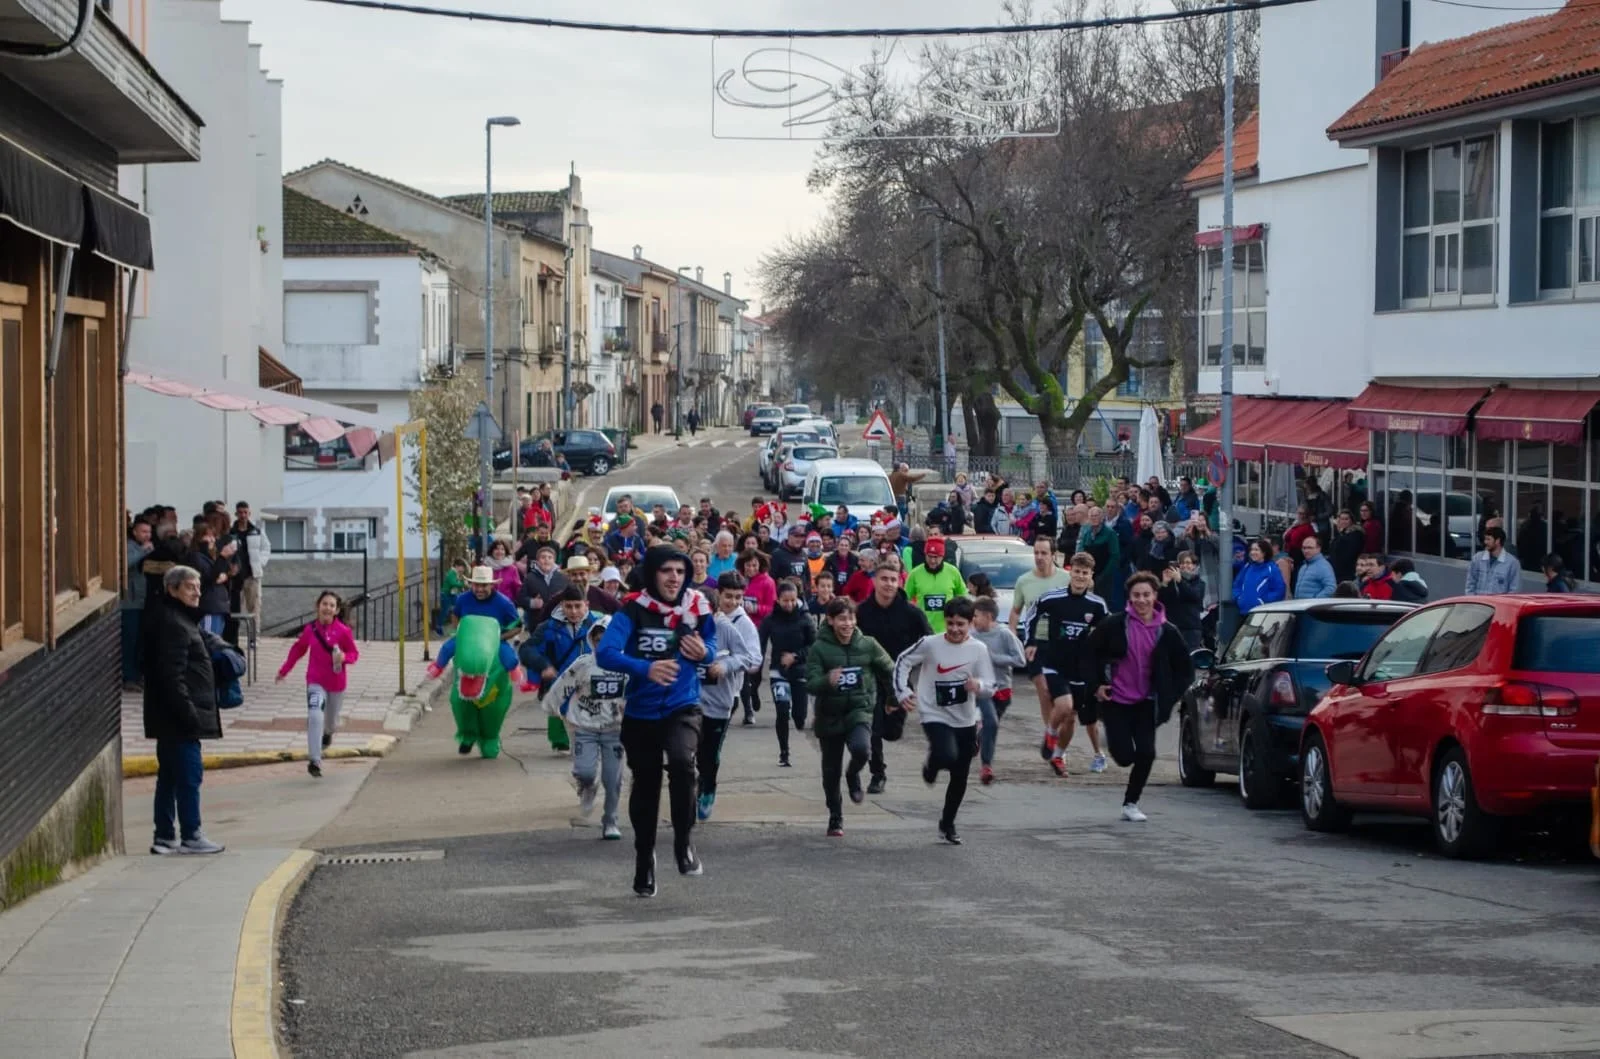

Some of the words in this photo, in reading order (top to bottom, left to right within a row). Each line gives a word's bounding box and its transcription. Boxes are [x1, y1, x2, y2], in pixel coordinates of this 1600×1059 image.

[927, 598, 943, 608] 63
[1065, 625, 1084, 637] 37
[638, 636, 668, 652] 26
[596, 681, 619, 694] 85
[948, 687, 957, 699] 1
